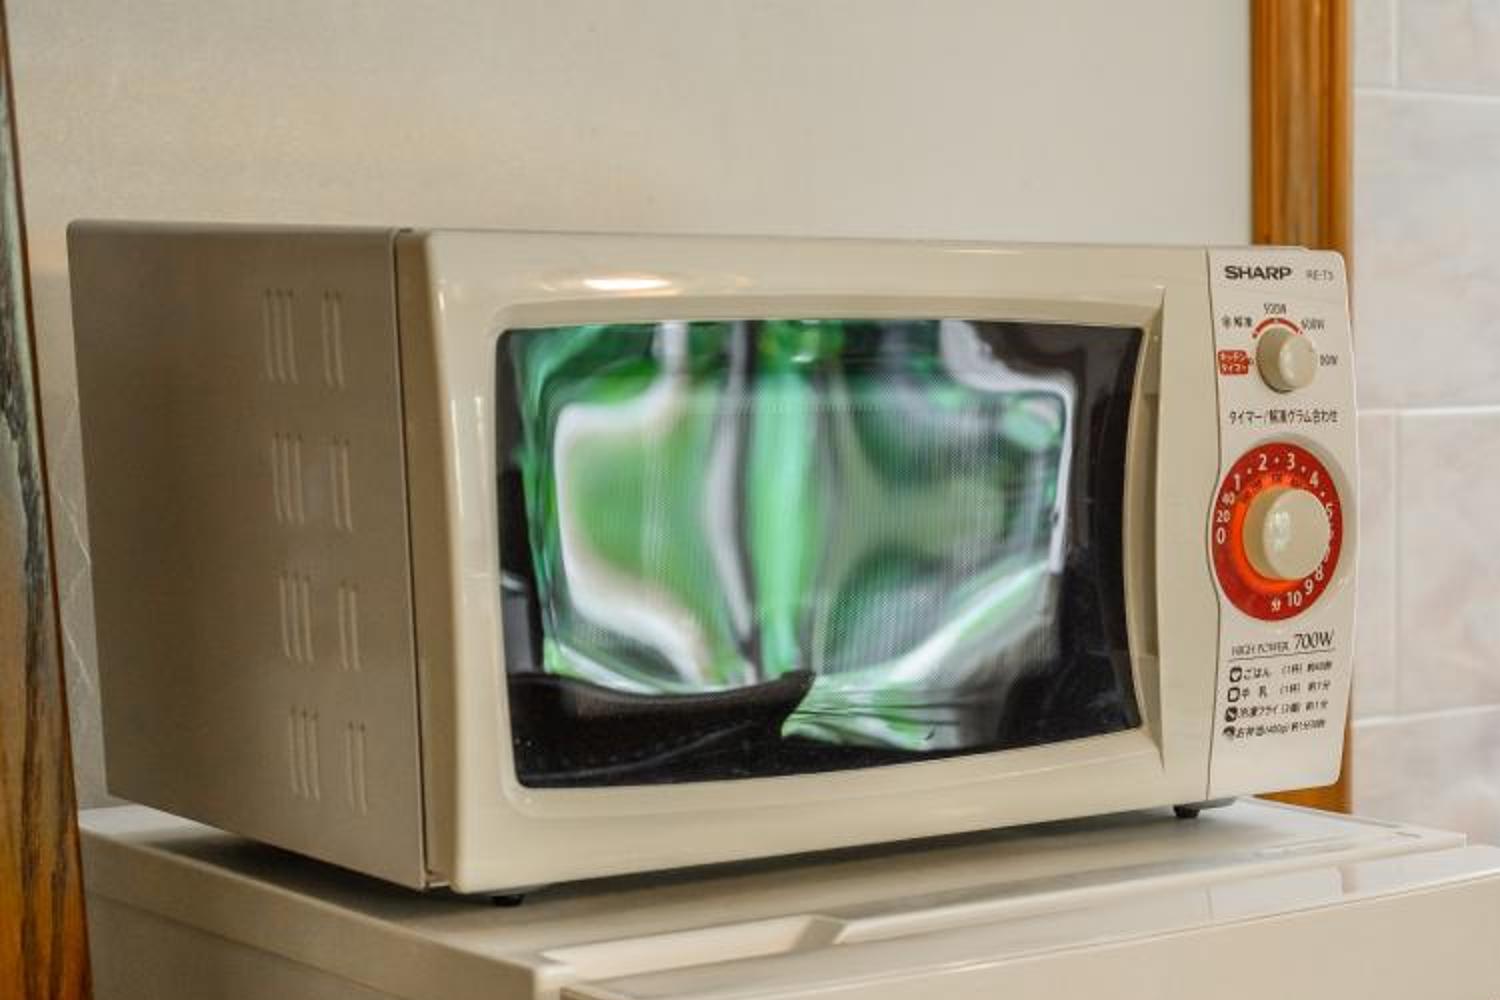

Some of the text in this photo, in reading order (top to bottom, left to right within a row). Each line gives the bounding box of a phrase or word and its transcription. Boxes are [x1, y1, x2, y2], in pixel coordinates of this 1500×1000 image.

[1224, 265, 1292, 281] SHARP
[1258, 454, 1268, 471] 2
[1286, 452, 1296, 471] 3
[1233, 473, 1241, 491] 1
[1309, 471, 1320, 489] 4
[1217, 510, 1231, 523] 20
[1216, 528, 1227, 545] 0
[1305, 579, 1315, 596] 9
[1286, 591, 1302, 608] 10
[1294, 629, 1335, 650] 700W
